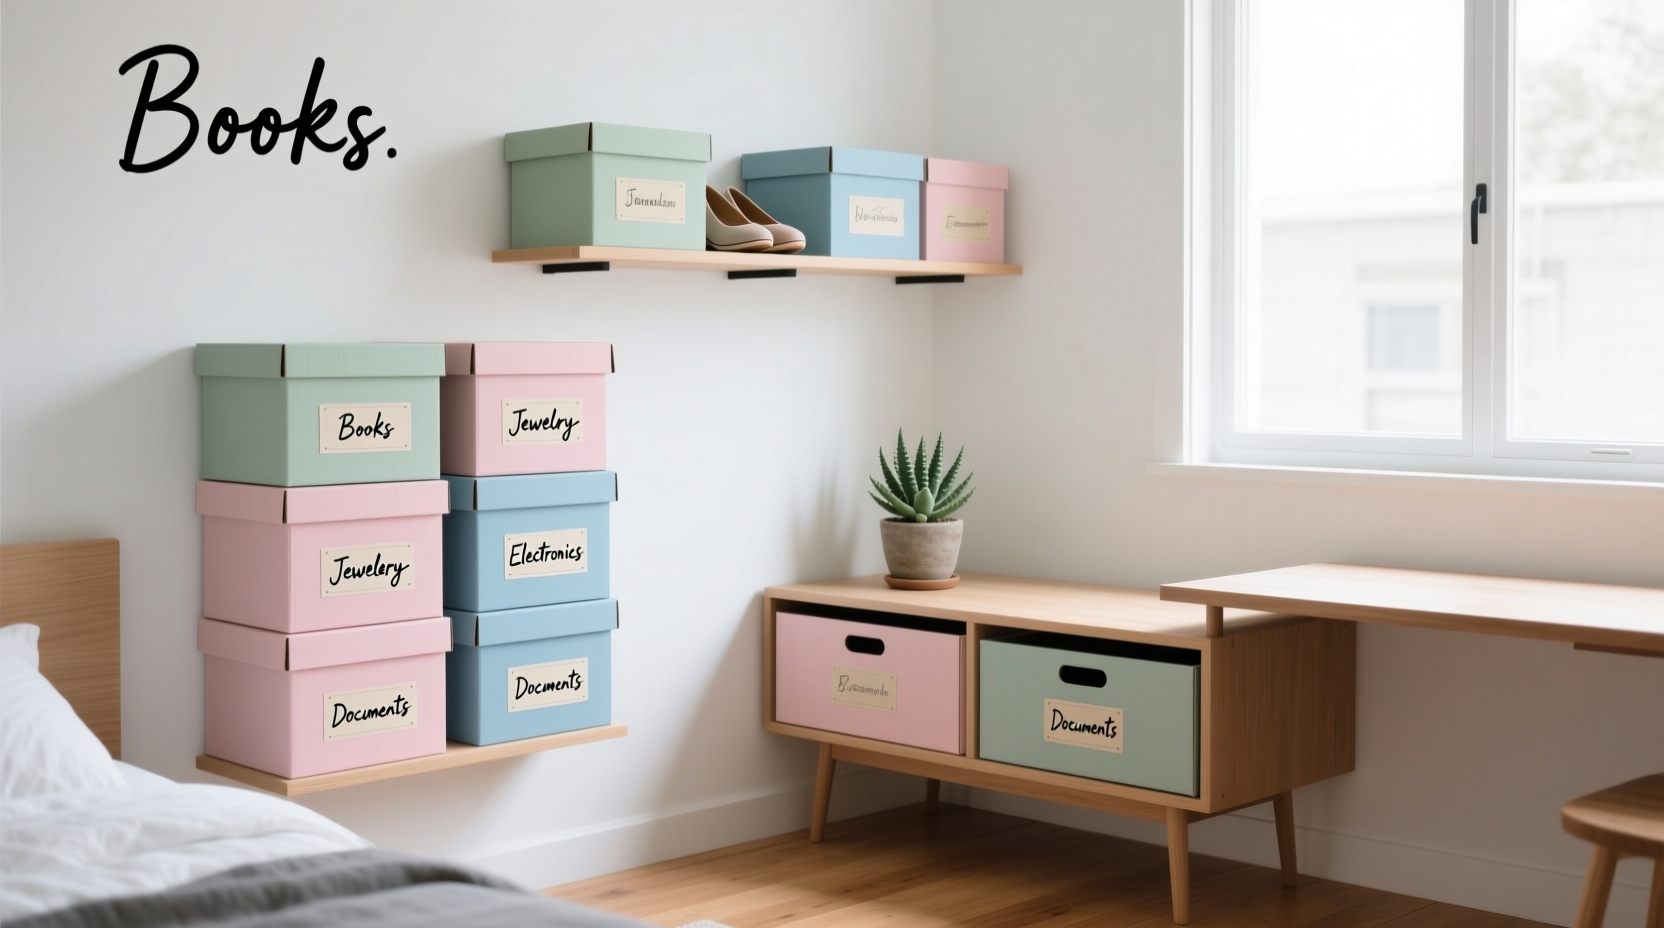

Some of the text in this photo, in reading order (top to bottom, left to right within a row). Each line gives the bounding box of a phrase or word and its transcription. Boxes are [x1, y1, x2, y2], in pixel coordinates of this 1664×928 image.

[338, 411, 395, 441] Books
[509, 409, 580, 442] Jewelry
[510, 542, 584, 567] Electronics
[330, 553, 409, 588] Jewelery
[332, 695, 410, 728] Documents
[1051, 709, 1118, 739] Documents
